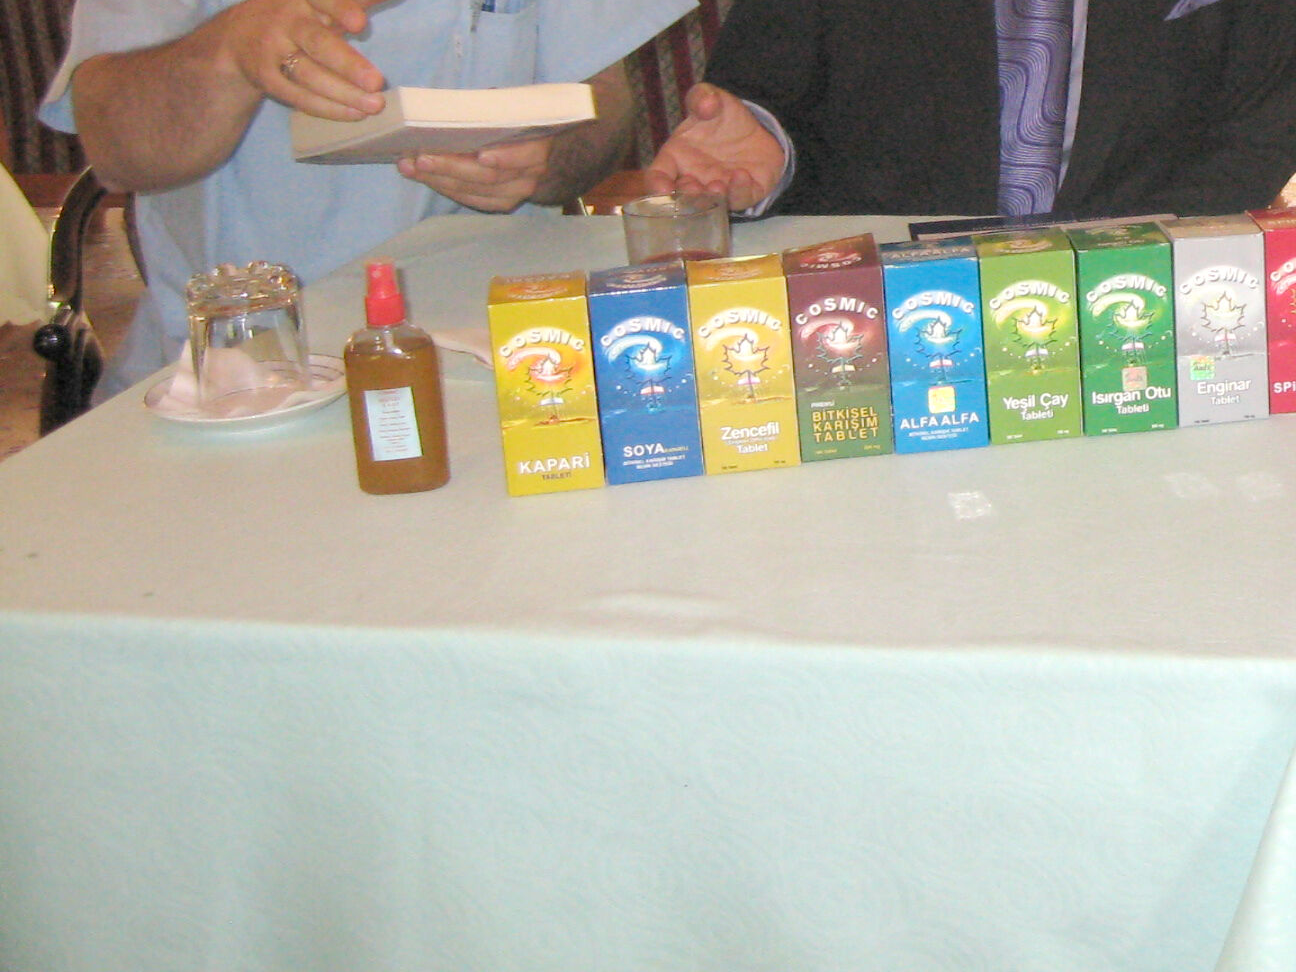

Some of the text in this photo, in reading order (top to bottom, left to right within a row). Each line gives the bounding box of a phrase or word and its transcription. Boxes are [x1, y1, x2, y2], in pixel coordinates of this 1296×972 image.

[1086, 275, 1167, 303] COSMIC
[1180, 267, 1260, 295] COSMIC
[892, 291, 975, 319] COSMIC
[989, 282, 1071, 310] COSMIC
[796, 297, 880, 325] COSMIC
[601, 317, 685, 347] COSMIC
[698, 309, 783, 338] COSMIC
[500, 328, 586, 358] COSMIC
[1145, 385, 1172, 400] Otu
[1197, 379, 1252, 396] Enginar
[1003, 393, 1069, 411] Yeşil Çay
[1211, 395, 1240, 405] Tablet
[812, 406, 877, 422] BİTKİSEL
[720, 421, 779, 440] Zencefil
[813, 416, 878, 432] KARIŞIM
[813, 426, 879, 443] TABLET
[623, 442, 665, 458] SOYA
[736, 443, 768, 454] Tablet
[518, 451, 591, 474] KAPARİ
